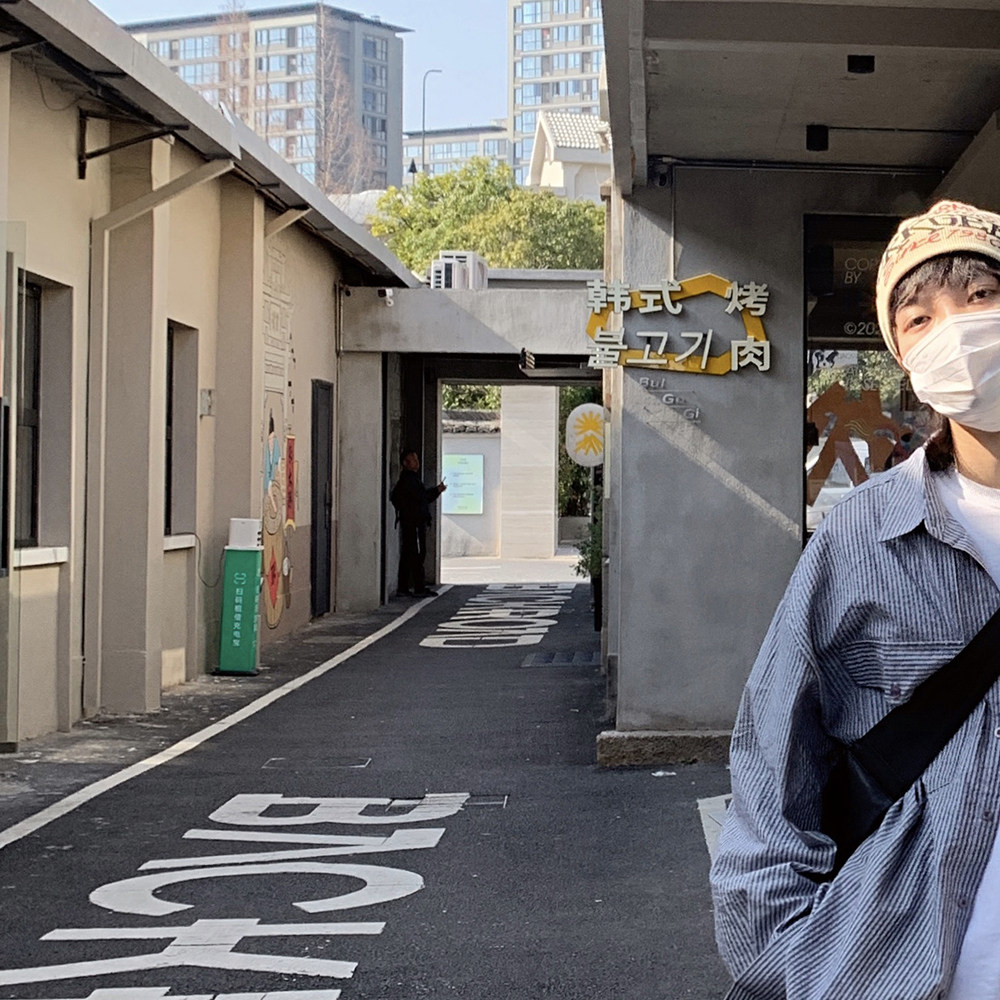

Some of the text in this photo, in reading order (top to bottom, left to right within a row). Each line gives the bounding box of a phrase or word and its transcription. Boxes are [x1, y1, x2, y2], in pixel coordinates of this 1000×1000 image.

[844, 271, 862, 284] BY
[586, 279, 770, 316] 韩式 烤
[587, 326, 713, 370] 불고기
[730, 335, 771, 372] 肉
[639, 376, 666, 389] Bul
[419, 583, 577, 648] BACKROAD
